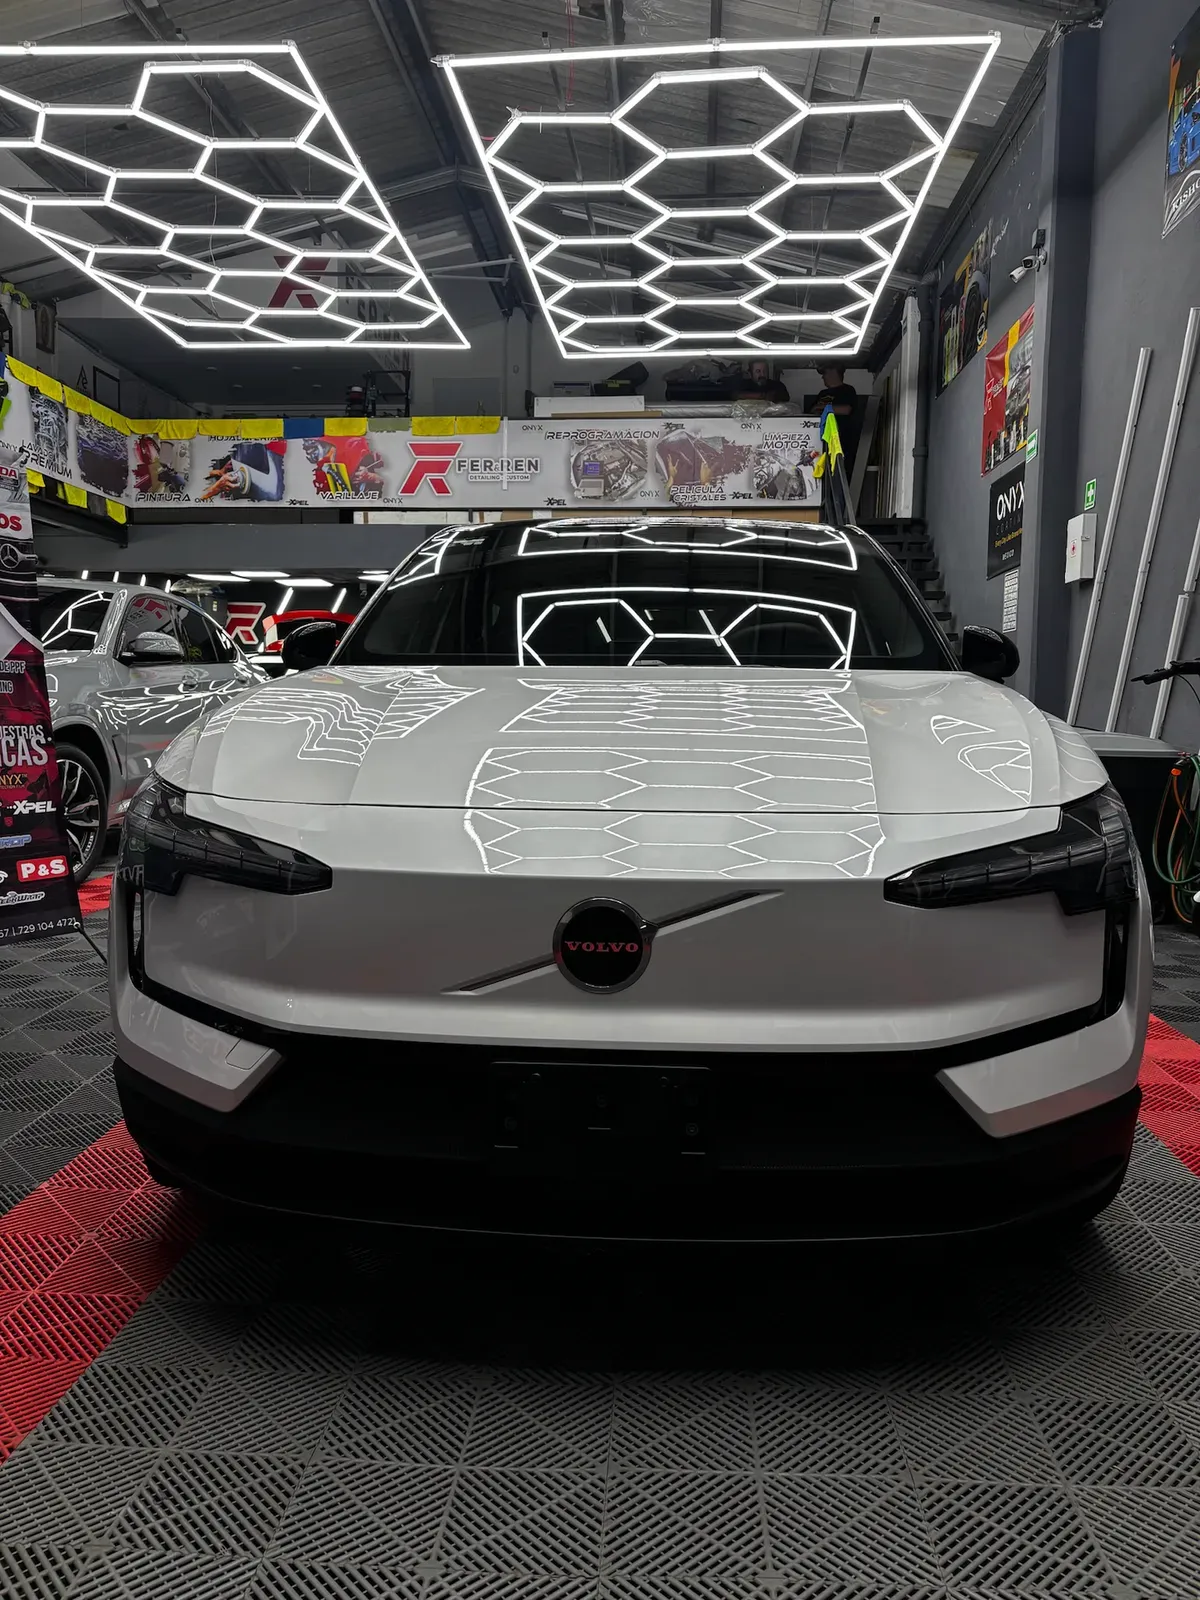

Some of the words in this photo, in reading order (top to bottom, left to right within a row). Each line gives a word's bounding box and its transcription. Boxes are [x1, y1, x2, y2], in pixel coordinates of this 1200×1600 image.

[546, 431, 660, 440] REPROGRAMACION
[764, 433, 811, 441] LIMPIEZA
[763, 440, 809, 449] MOTOR
[20, 448, 73, 479] PREMIUM
[671, 486, 724, 494] PELICULA
[137, 493, 191, 502] PINTURA
[320, 492, 379, 500] VARILLAJE
[545, 497, 567, 506] XPEL
[0, 736, 48, 767] CAS
[13, 800, 56, 815] XPEL
[18, 924, 36, 934] 729
[37, 921, 54, 931] 104
[564, 941, 639, 953] VOLVO
